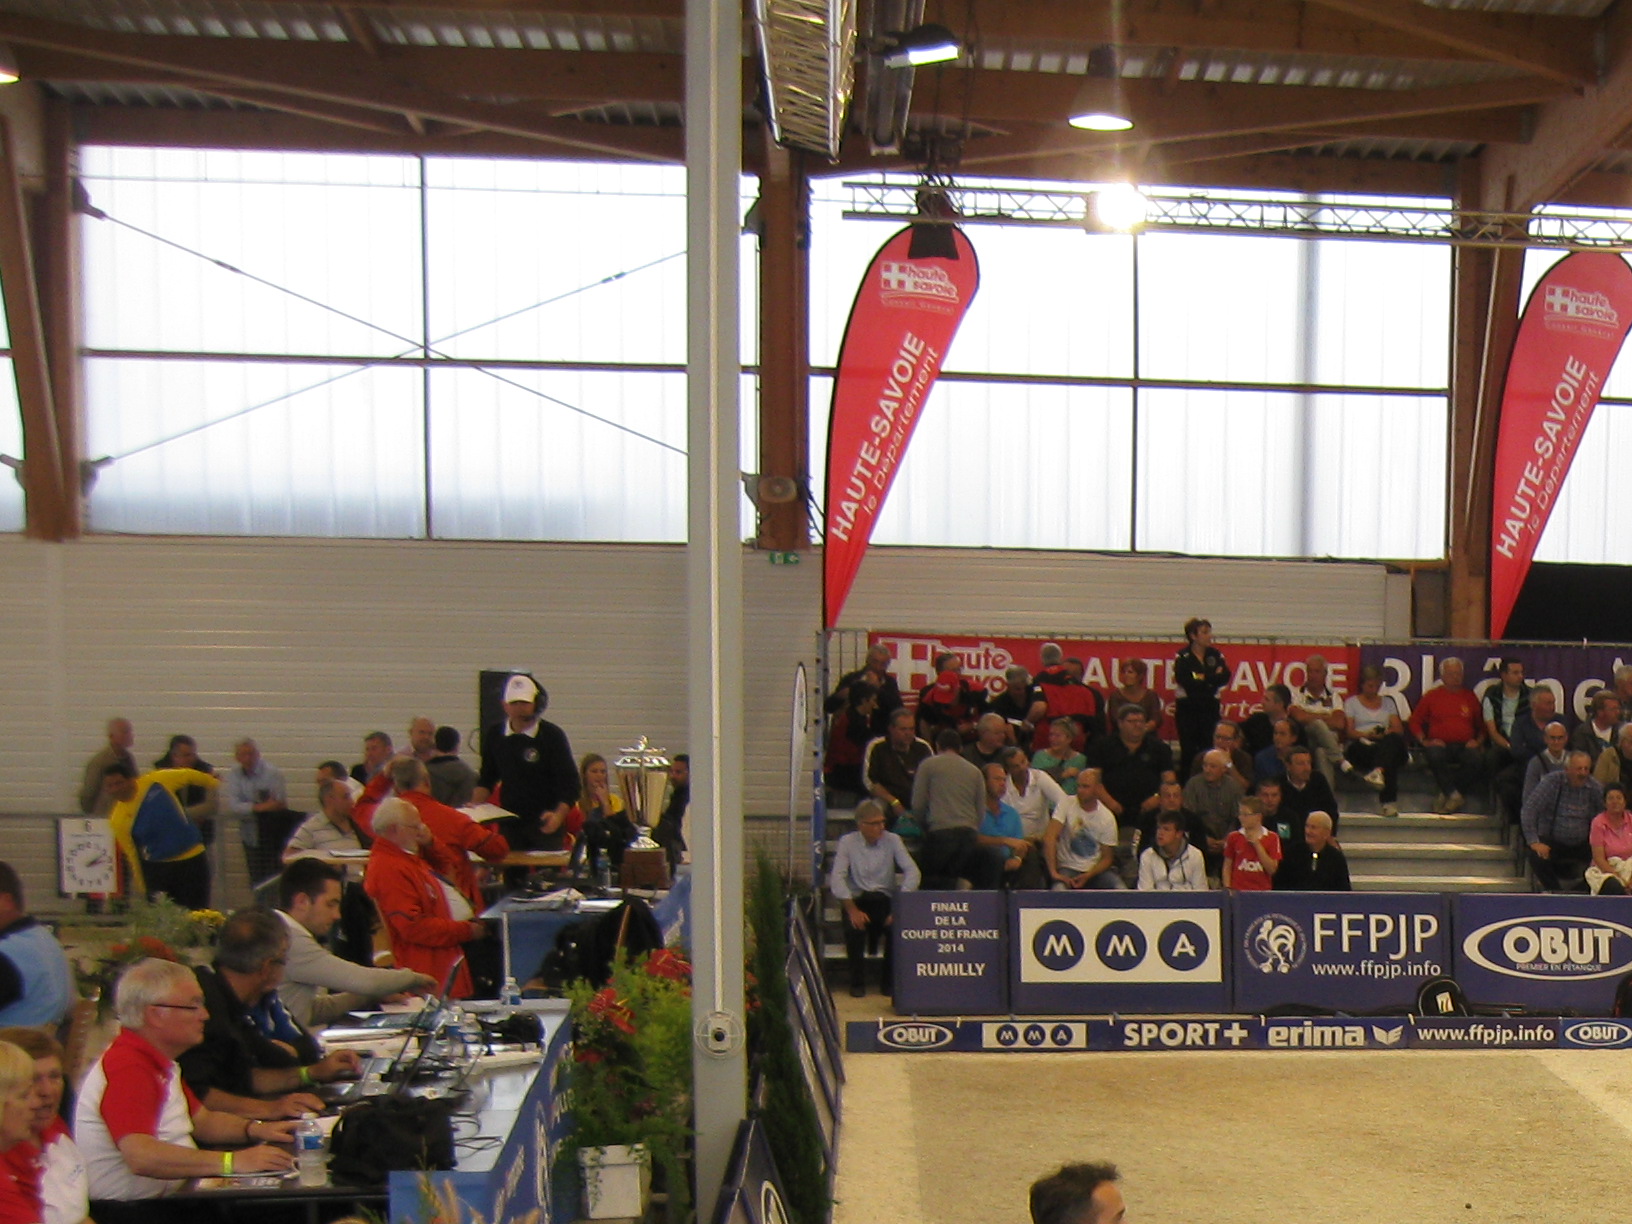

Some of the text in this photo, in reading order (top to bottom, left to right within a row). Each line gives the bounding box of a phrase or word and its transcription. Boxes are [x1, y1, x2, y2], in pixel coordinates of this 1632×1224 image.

[831, 331, 926, 542] HAUTE-SAVOIE
[1496, 355, 1587, 559] HAUTE-SAVOIE
[931, 902, 969, 913] FINALE
[935, 916, 967, 926] DE LA
[901, 929, 999, 940] COUPE DE FRANCE
[1313, 913, 1439, 960] FFPJP
[937, 943, 965, 953] 2014
[1503, 926, 1616, 964] OBUT
[916, 963, 986, 977] RUMILLY
[1312, 960, 1441, 979] www.ffpjp.info
[892, 1027, 938, 1043] OBUT
[1123, 1022, 1249, 1047] SPORT+
[1267, 1021, 1365, 1047] erima
[1417, 1023, 1555, 1045] www.ffpjp.info
[1578, 1026, 1619, 1041] OBUT
